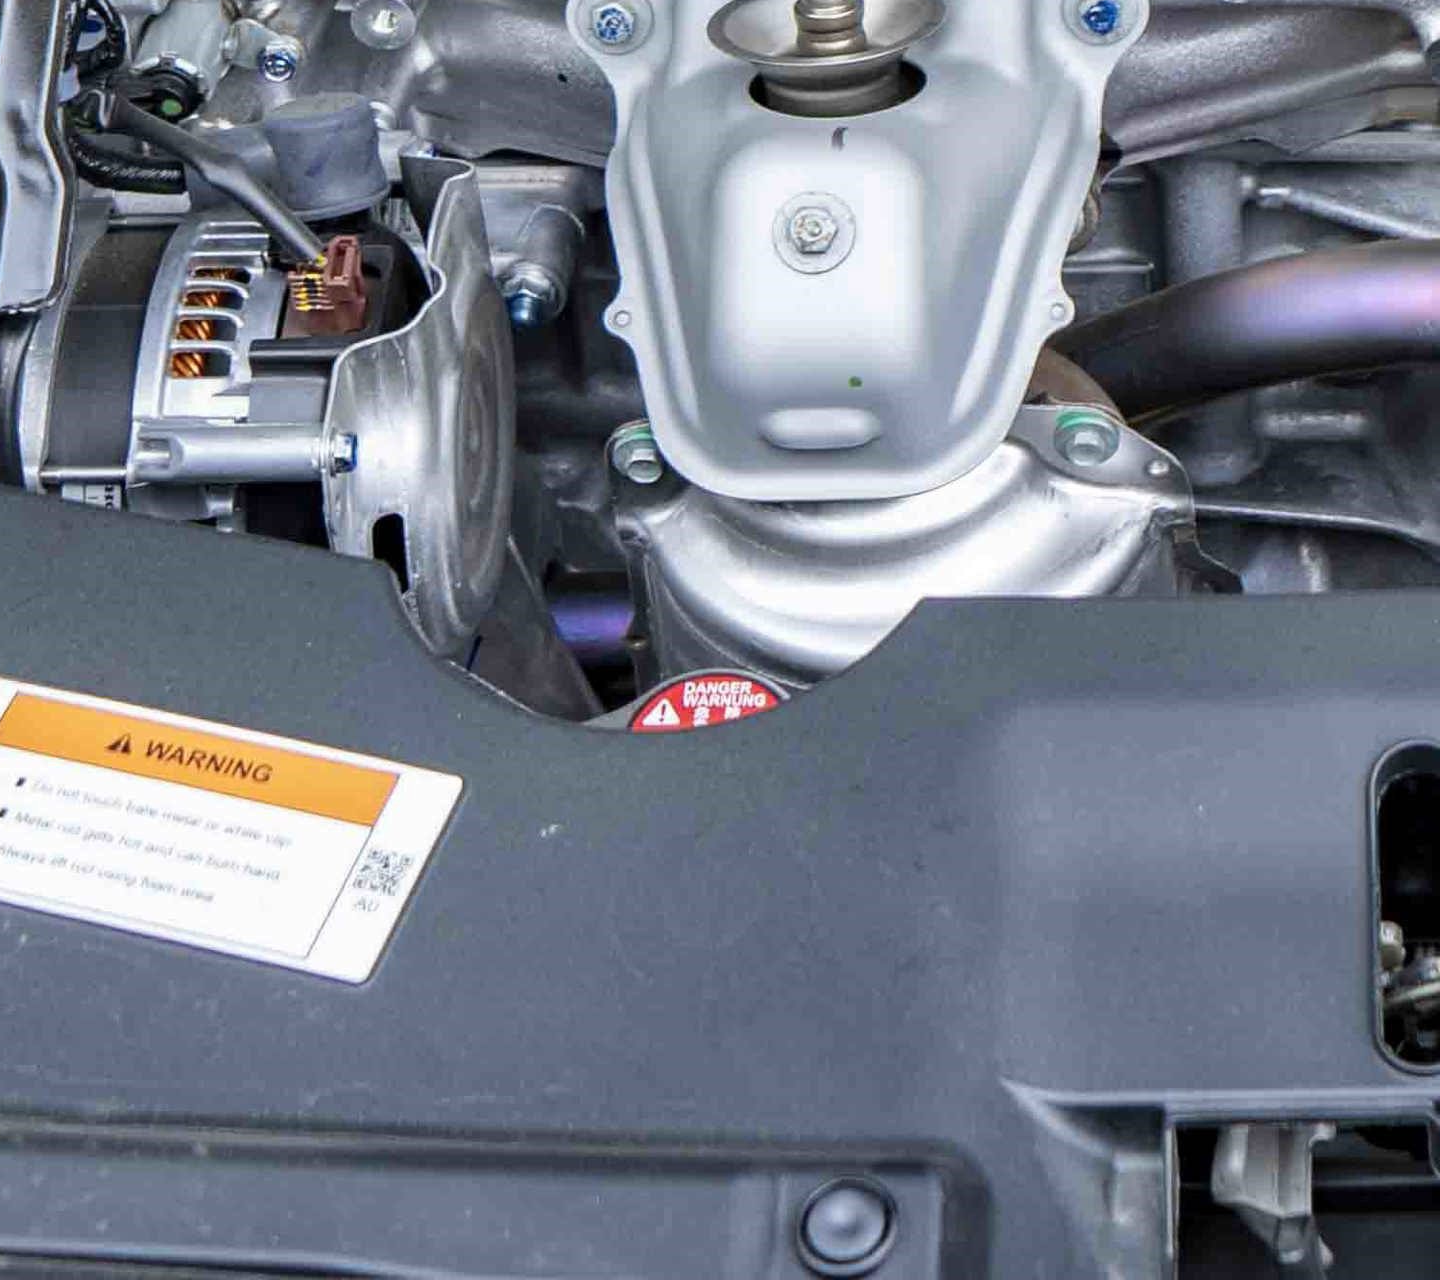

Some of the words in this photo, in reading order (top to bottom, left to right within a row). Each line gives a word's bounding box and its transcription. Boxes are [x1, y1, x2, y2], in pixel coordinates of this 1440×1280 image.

[683, 681, 753, 693] DANGER
[682, 692, 767, 707] WARNUNG
[145, 739, 273, 784] WARNING
